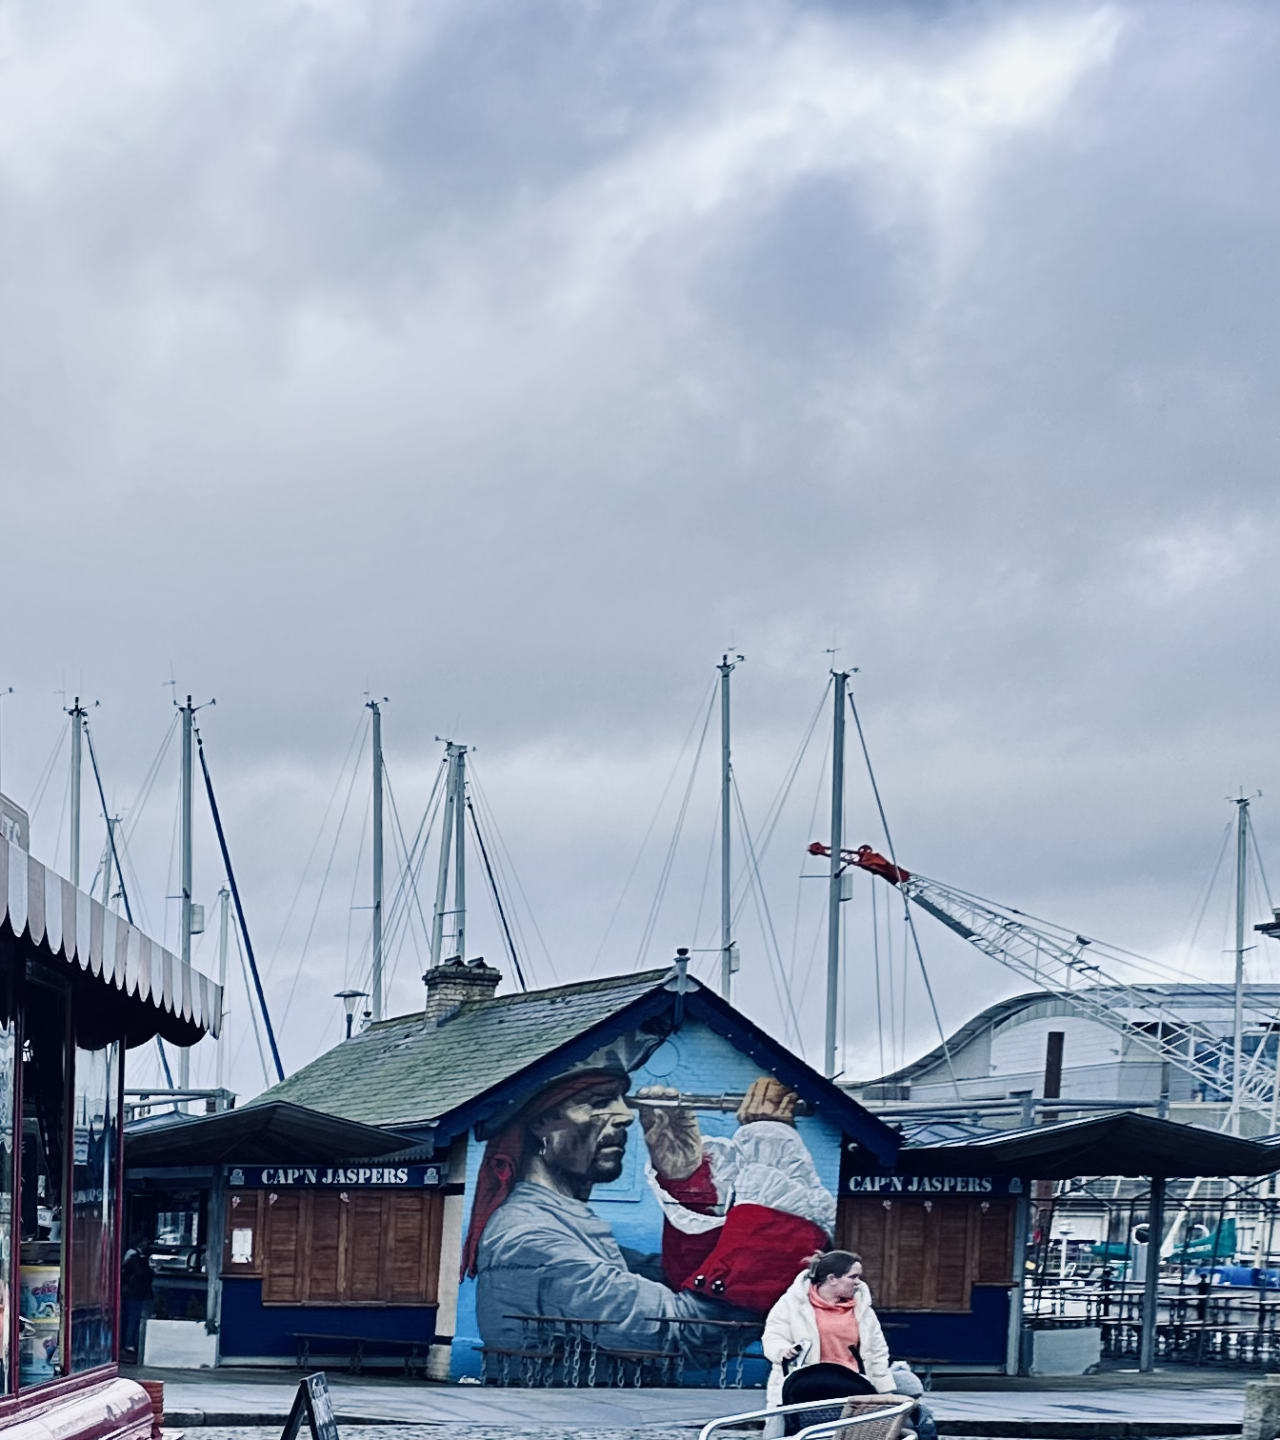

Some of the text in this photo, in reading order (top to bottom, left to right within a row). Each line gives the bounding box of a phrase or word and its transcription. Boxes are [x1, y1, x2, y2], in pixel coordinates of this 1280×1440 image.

[261, 1167, 408, 1185] CAP'N JASPERS
[848, 1176, 992, 1192] CAP'N JASPERS
